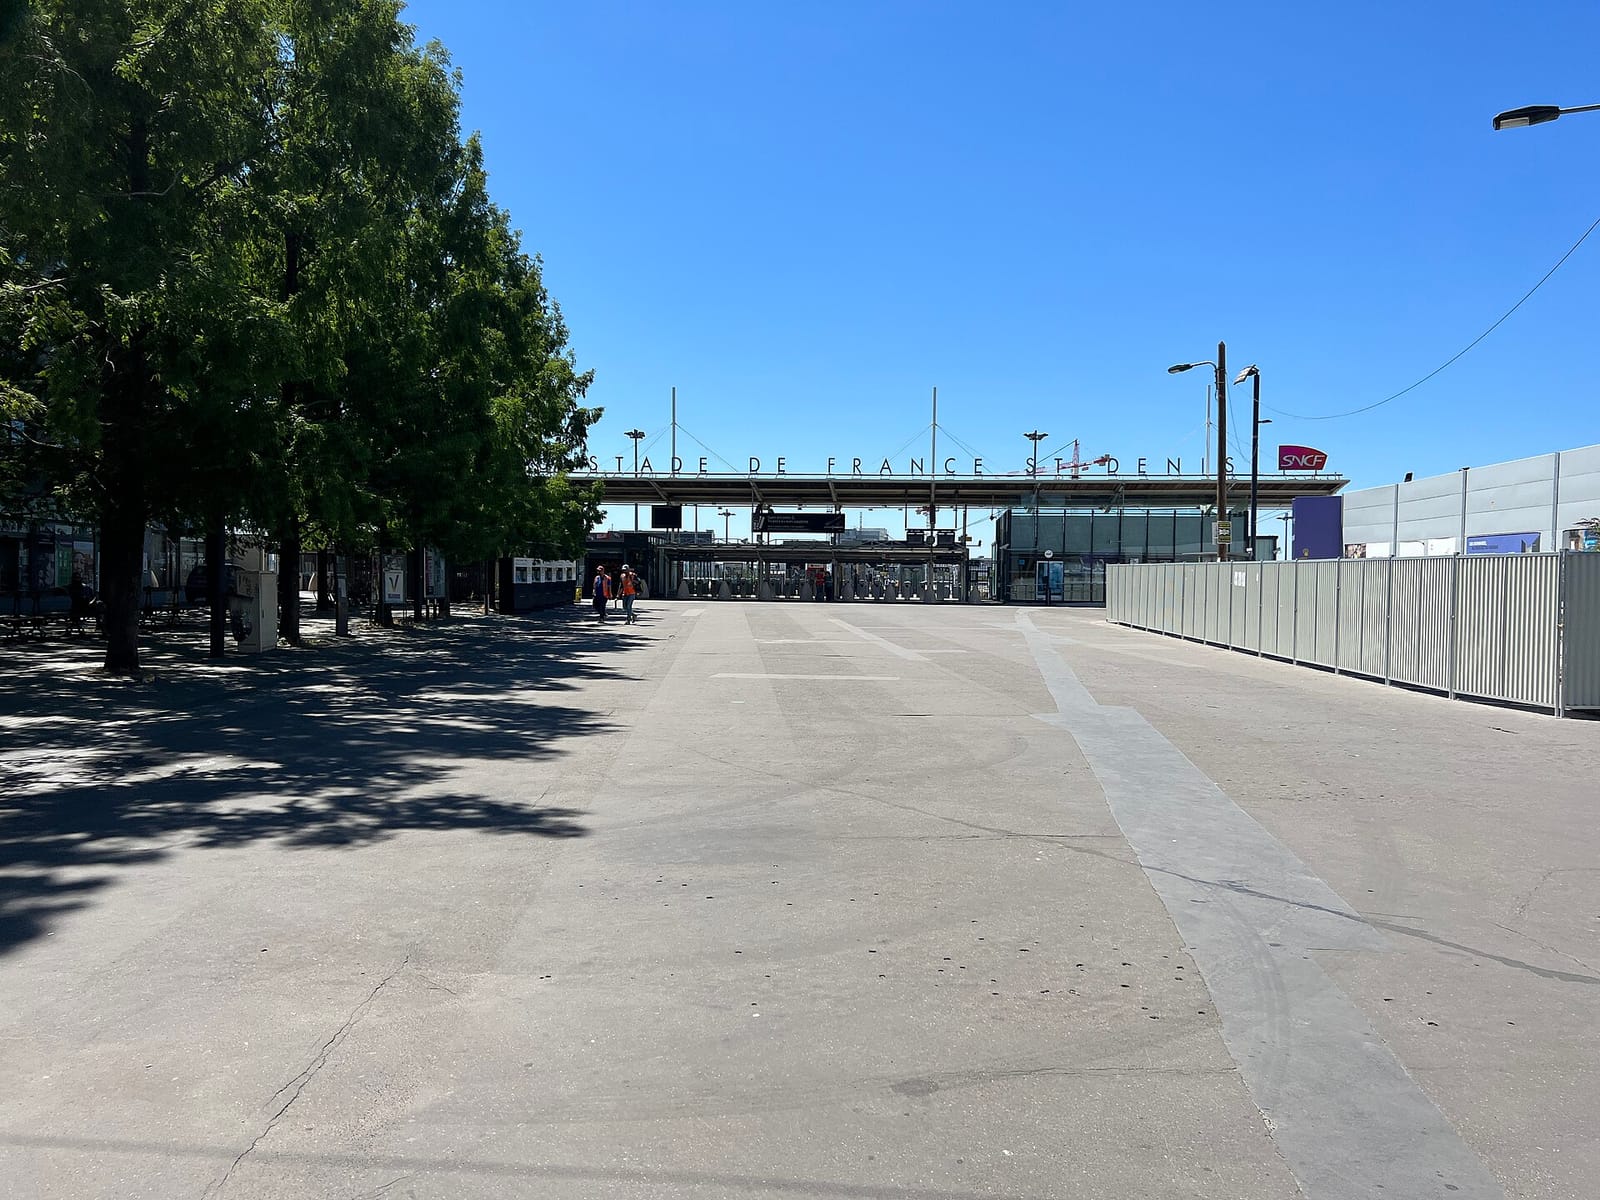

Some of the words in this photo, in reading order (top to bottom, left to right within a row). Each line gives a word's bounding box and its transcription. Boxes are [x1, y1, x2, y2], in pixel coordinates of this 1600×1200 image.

[589, 456, 708, 473] STADE
[749, 457, 786, 473] DE
[827, 457, 982, 474] FRANCE
[1025, 457, 1063, 474] ST
[1107, 456, 1235, 474] DENIS
[1280, 454, 1326, 467] SNCF
